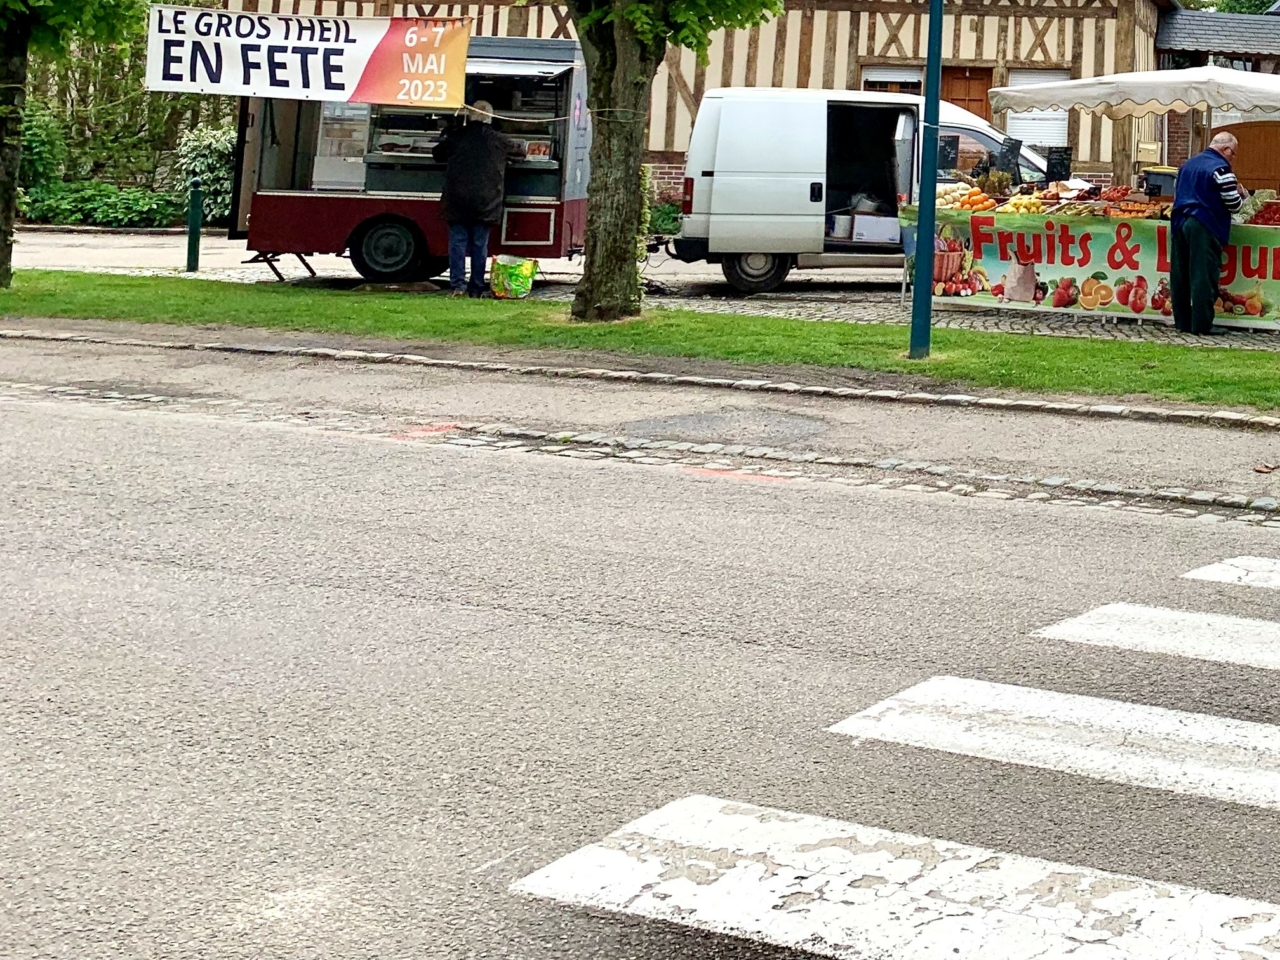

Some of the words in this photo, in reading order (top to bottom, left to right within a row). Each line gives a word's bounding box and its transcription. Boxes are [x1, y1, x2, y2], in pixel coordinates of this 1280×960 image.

[157, 9, 187, 35] LE
[194, 11, 271, 40] GROS
[276, 16, 357, 44] THEIL
[161, 38, 223, 84] EN
[240, 43, 346, 92] FETE
[402, 52, 447, 75] MAI
[396, 78, 448, 102] 2023
[969, 215, 1093, 268] Fruits
[1106, 221, 1141, 271] &
